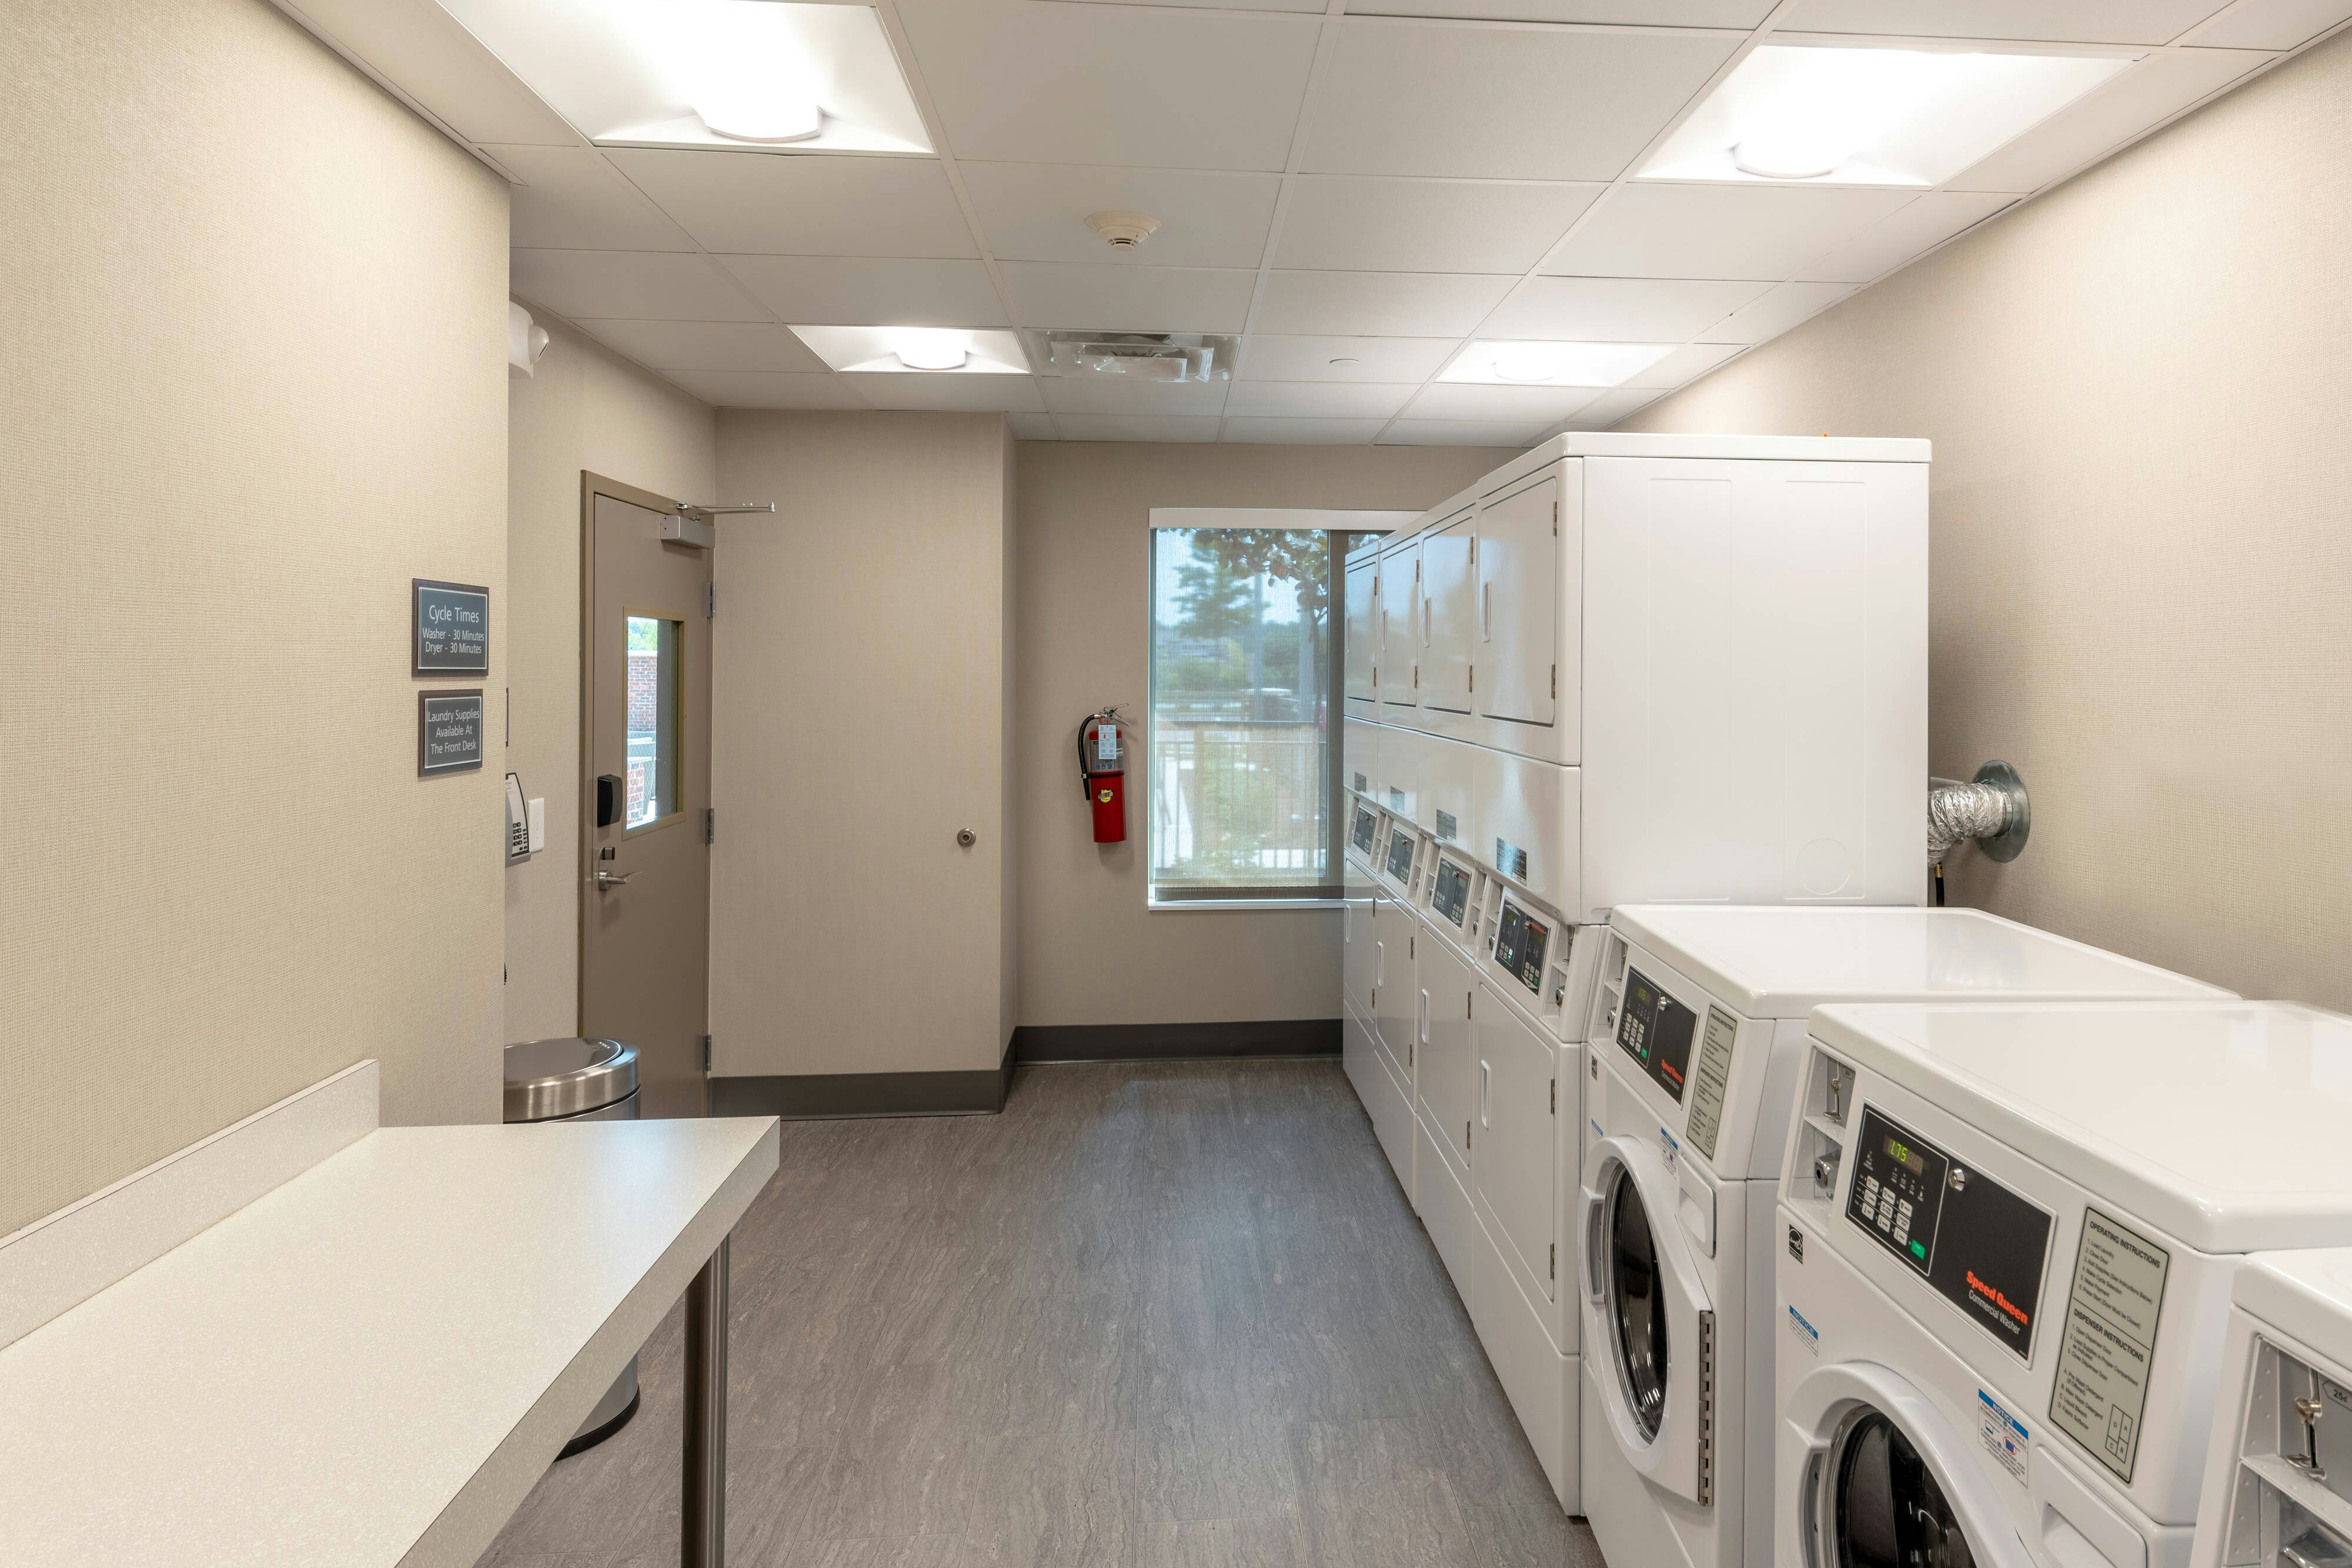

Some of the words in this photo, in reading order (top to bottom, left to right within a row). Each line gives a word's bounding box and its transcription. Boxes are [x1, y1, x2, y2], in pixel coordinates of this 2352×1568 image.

[429, 605, 452, 624] Cycle
[454, 607, 479, 623] Times
[422, 627, 446, 639] Washer
[453, 629, 460, 640] 30
[462, 630, 485, 641] Minutes
[425, 641, 443, 655] Dryer
[450, 642, 457, 653] 30
[459, 643, 482, 653] Minutes
[428, 710, 454, 723] Laundry
[455, 708, 479, 722] Supplies
[436, 724, 464, 738] Available
[465, 724, 473, 734] At
[430, 743, 443, 754] The
[445, 742, 461, 753] Front
[462, 739, 477, 750] Desk
[2090, 1221, 2119, 1243] OPERATING
[2120, 1239, 2160, 1268] INSTRUCTIONS
[1966, 1271, 1996, 1301] Speed
[1996, 1292, 2028, 1325] Queen
[1969, 1289, 1999, 1319] Commercial
[1999, 1312, 2020, 1335] Washer
[2074, 1309, 2103, 1333] DISPENSER
[2104, 1330, 2144, 1362] INSTRUCTIONS
[1992, 1402, 2014, 1425] NOTICE
[2109, 1442, 2114, 1450] C
